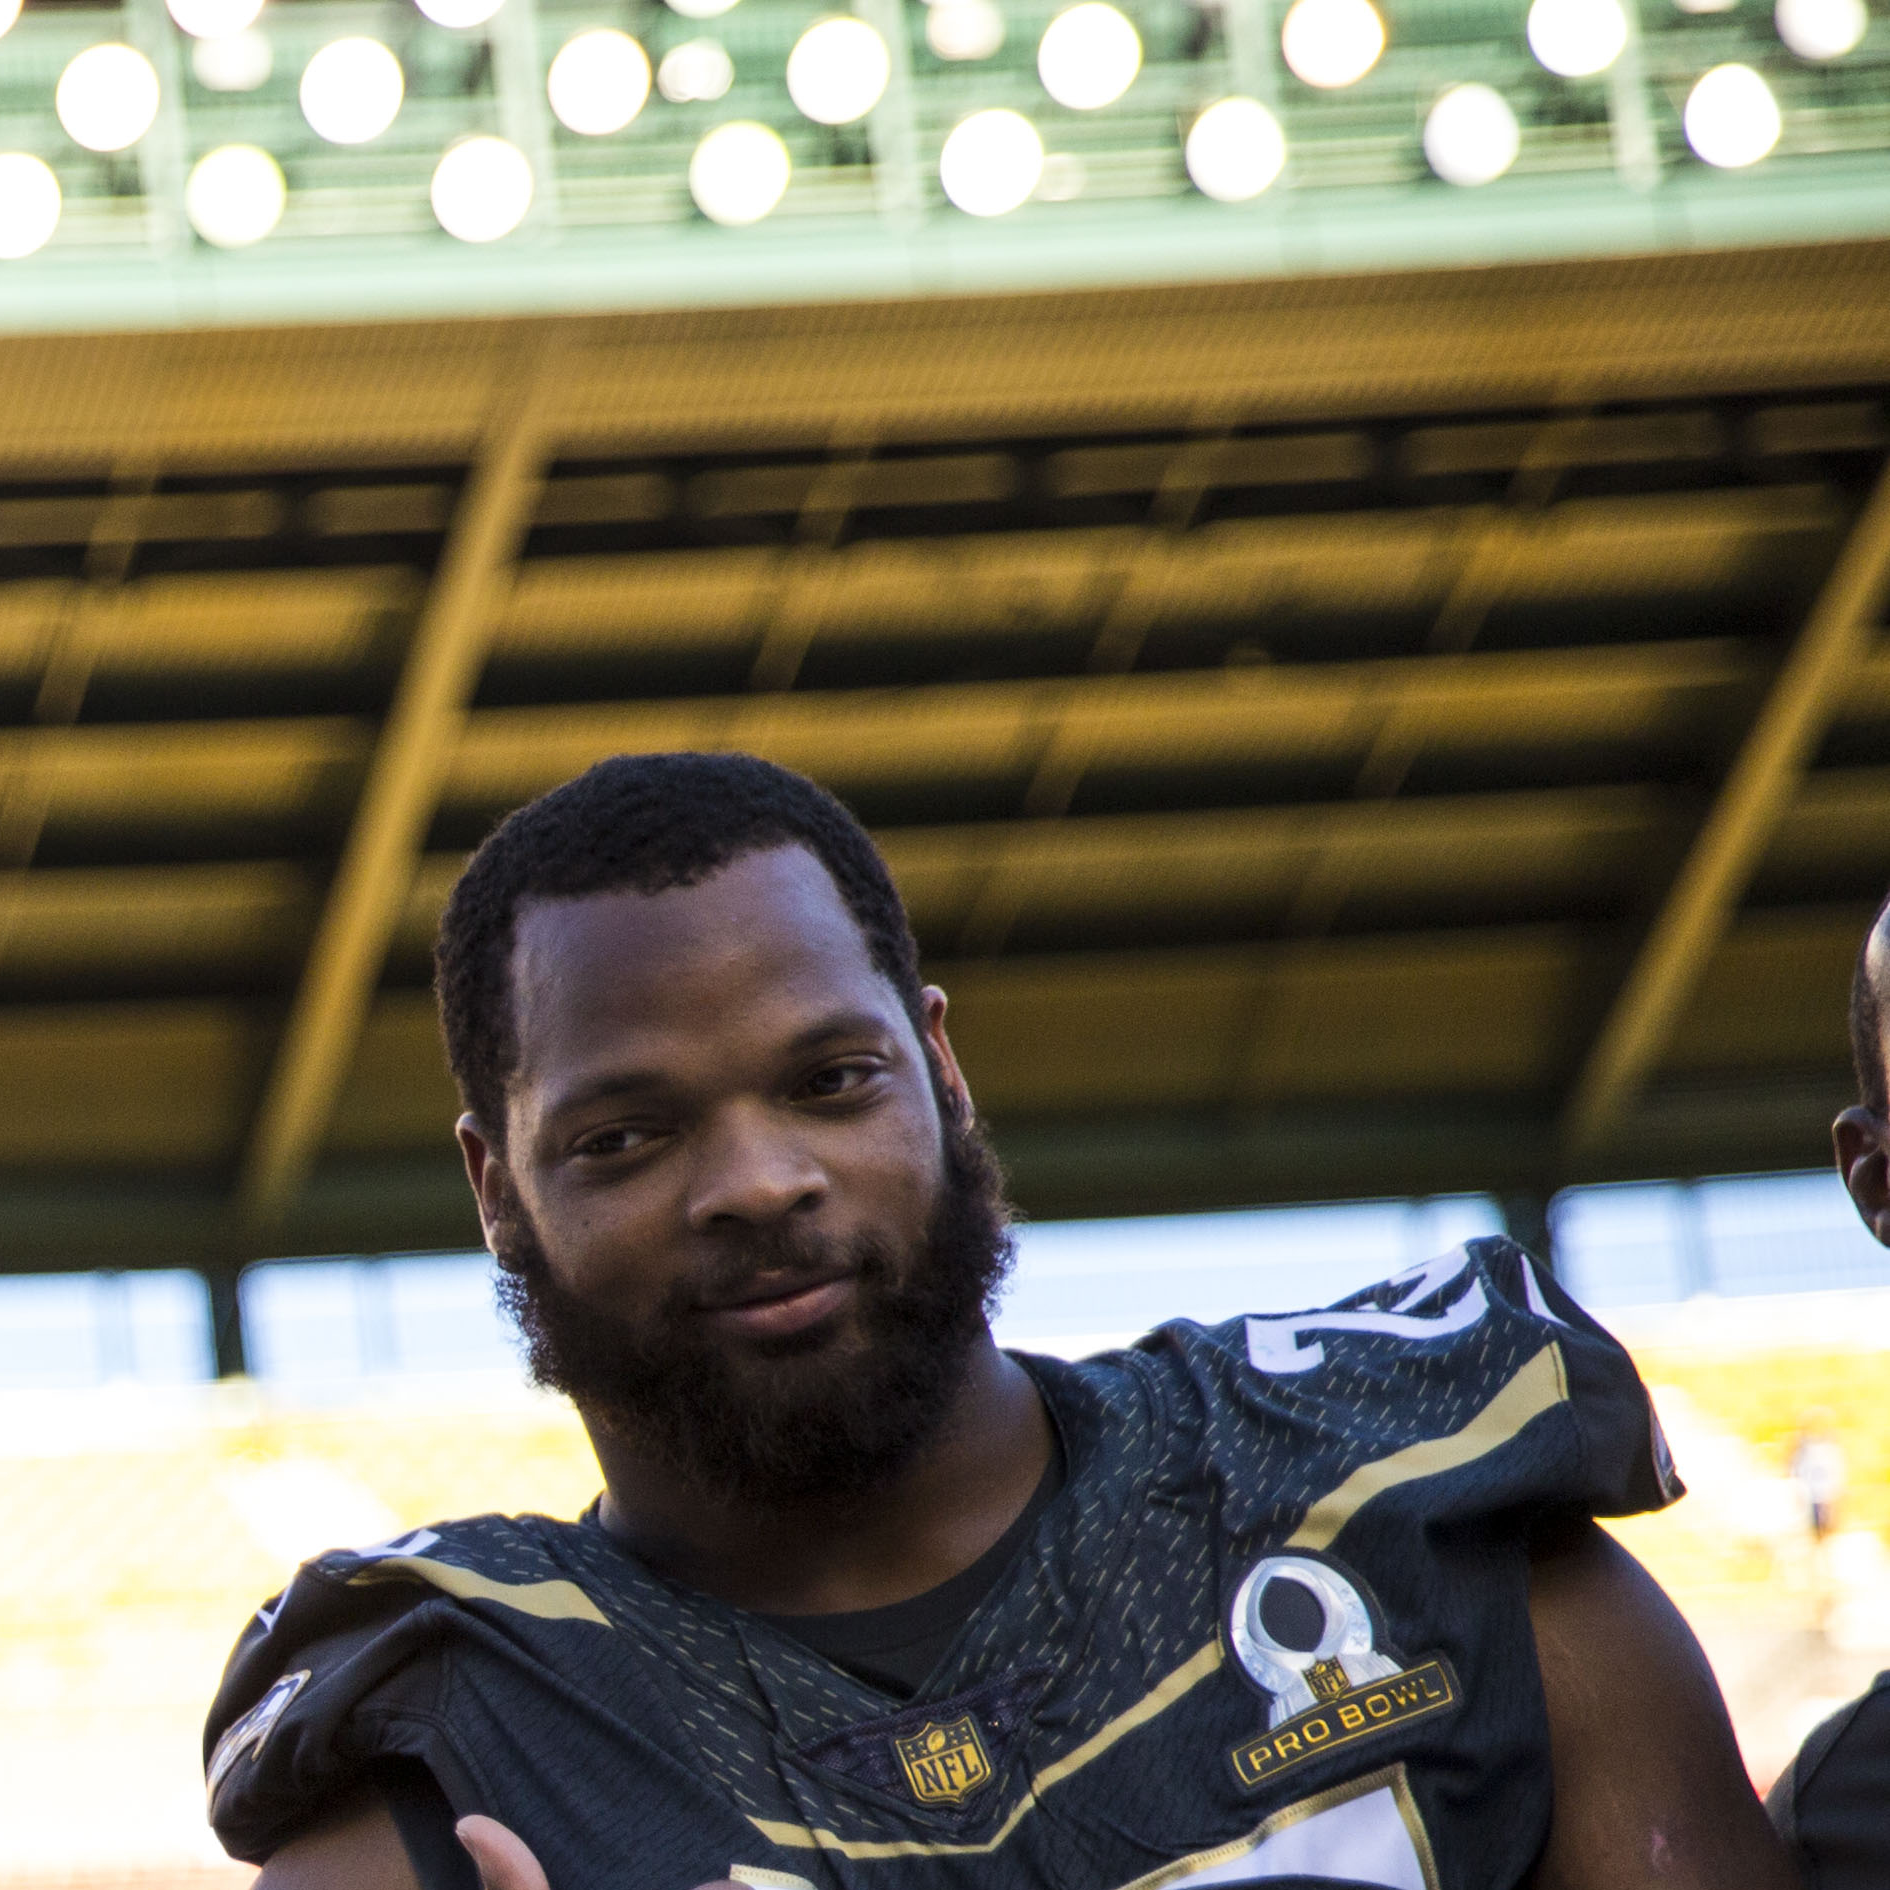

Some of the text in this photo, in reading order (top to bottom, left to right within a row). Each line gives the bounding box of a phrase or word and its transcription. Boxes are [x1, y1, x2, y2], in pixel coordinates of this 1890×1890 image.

[1311, 1668, 1346, 1695] NFL
[1248, 1677, 1441, 1772] PRO BOWL
[915, 1748, 980, 1794] NFL
